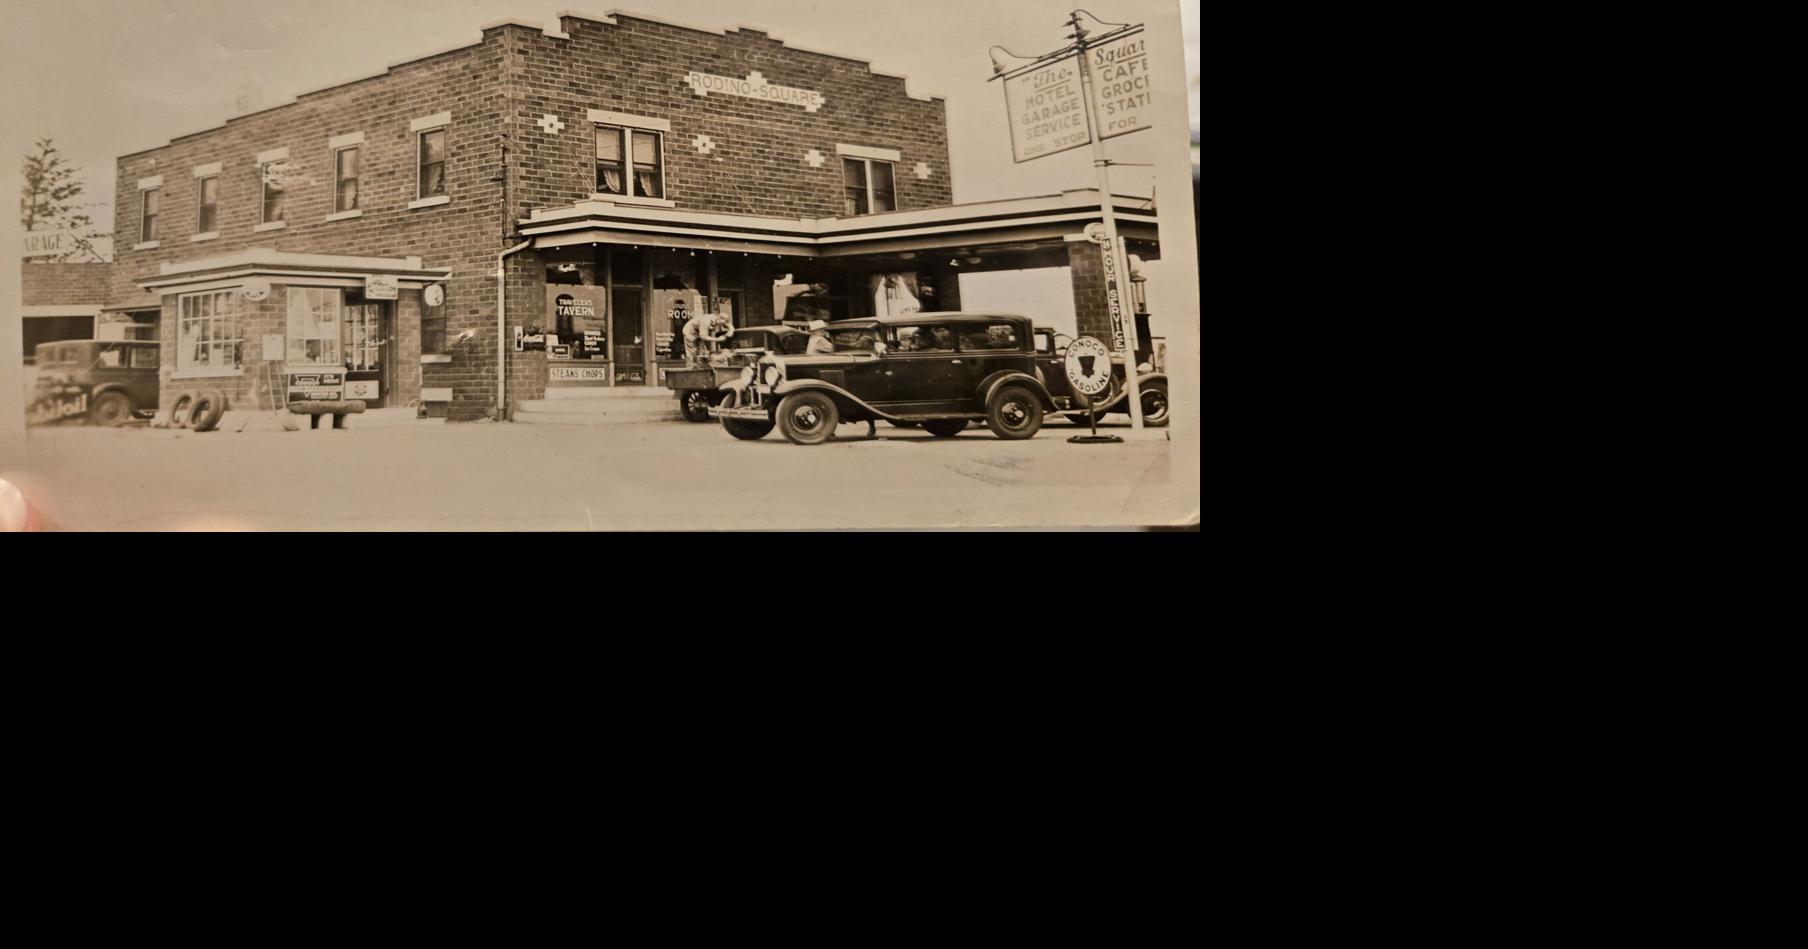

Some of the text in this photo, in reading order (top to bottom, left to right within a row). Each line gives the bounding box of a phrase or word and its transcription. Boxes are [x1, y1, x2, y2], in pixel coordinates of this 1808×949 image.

[691, 73, 819, 106] RODINO-SQUARE
[1025, 84, 1075, 109] HOTEL
[1021, 98, 1080, 126] GARAGE
[1023, 117, 1137, 155] ONE STOP FOR
[1025, 114, 1081, 140] SERVICE
[558, 305, 595, 316] TAVERN
[1109, 289, 1125, 349] SERVICE
[1067, 340, 1105, 358] CONOCO
[551, 368, 579, 378] STEAKS
[581, 368, 603, 378] CHOPS
[1069, 370, 1109, 392] GASOLINE
